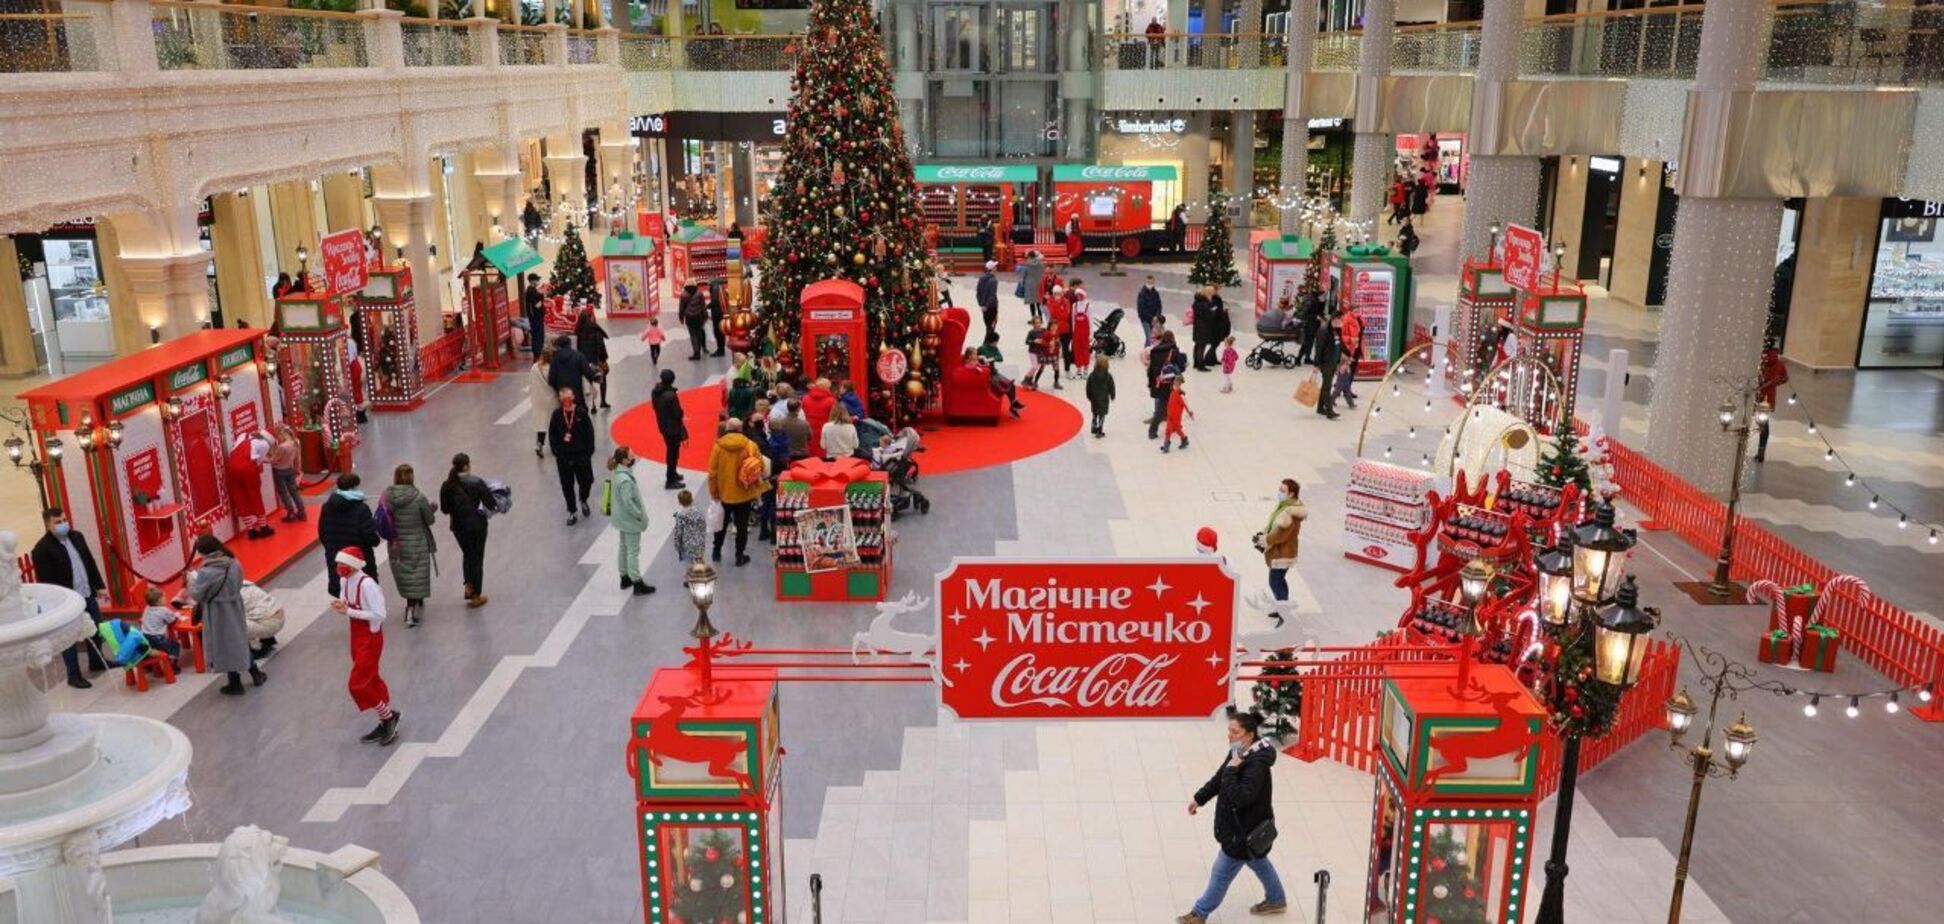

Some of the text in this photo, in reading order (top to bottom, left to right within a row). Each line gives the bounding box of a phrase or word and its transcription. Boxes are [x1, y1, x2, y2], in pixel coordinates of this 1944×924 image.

[1118, 119, 1171, 133] Timberland
[964, 577, 1132, 610] Магічне
[1007, 612, 1212, 644] Містечко
[991, 653, 1181, 708] Coca-Cola
